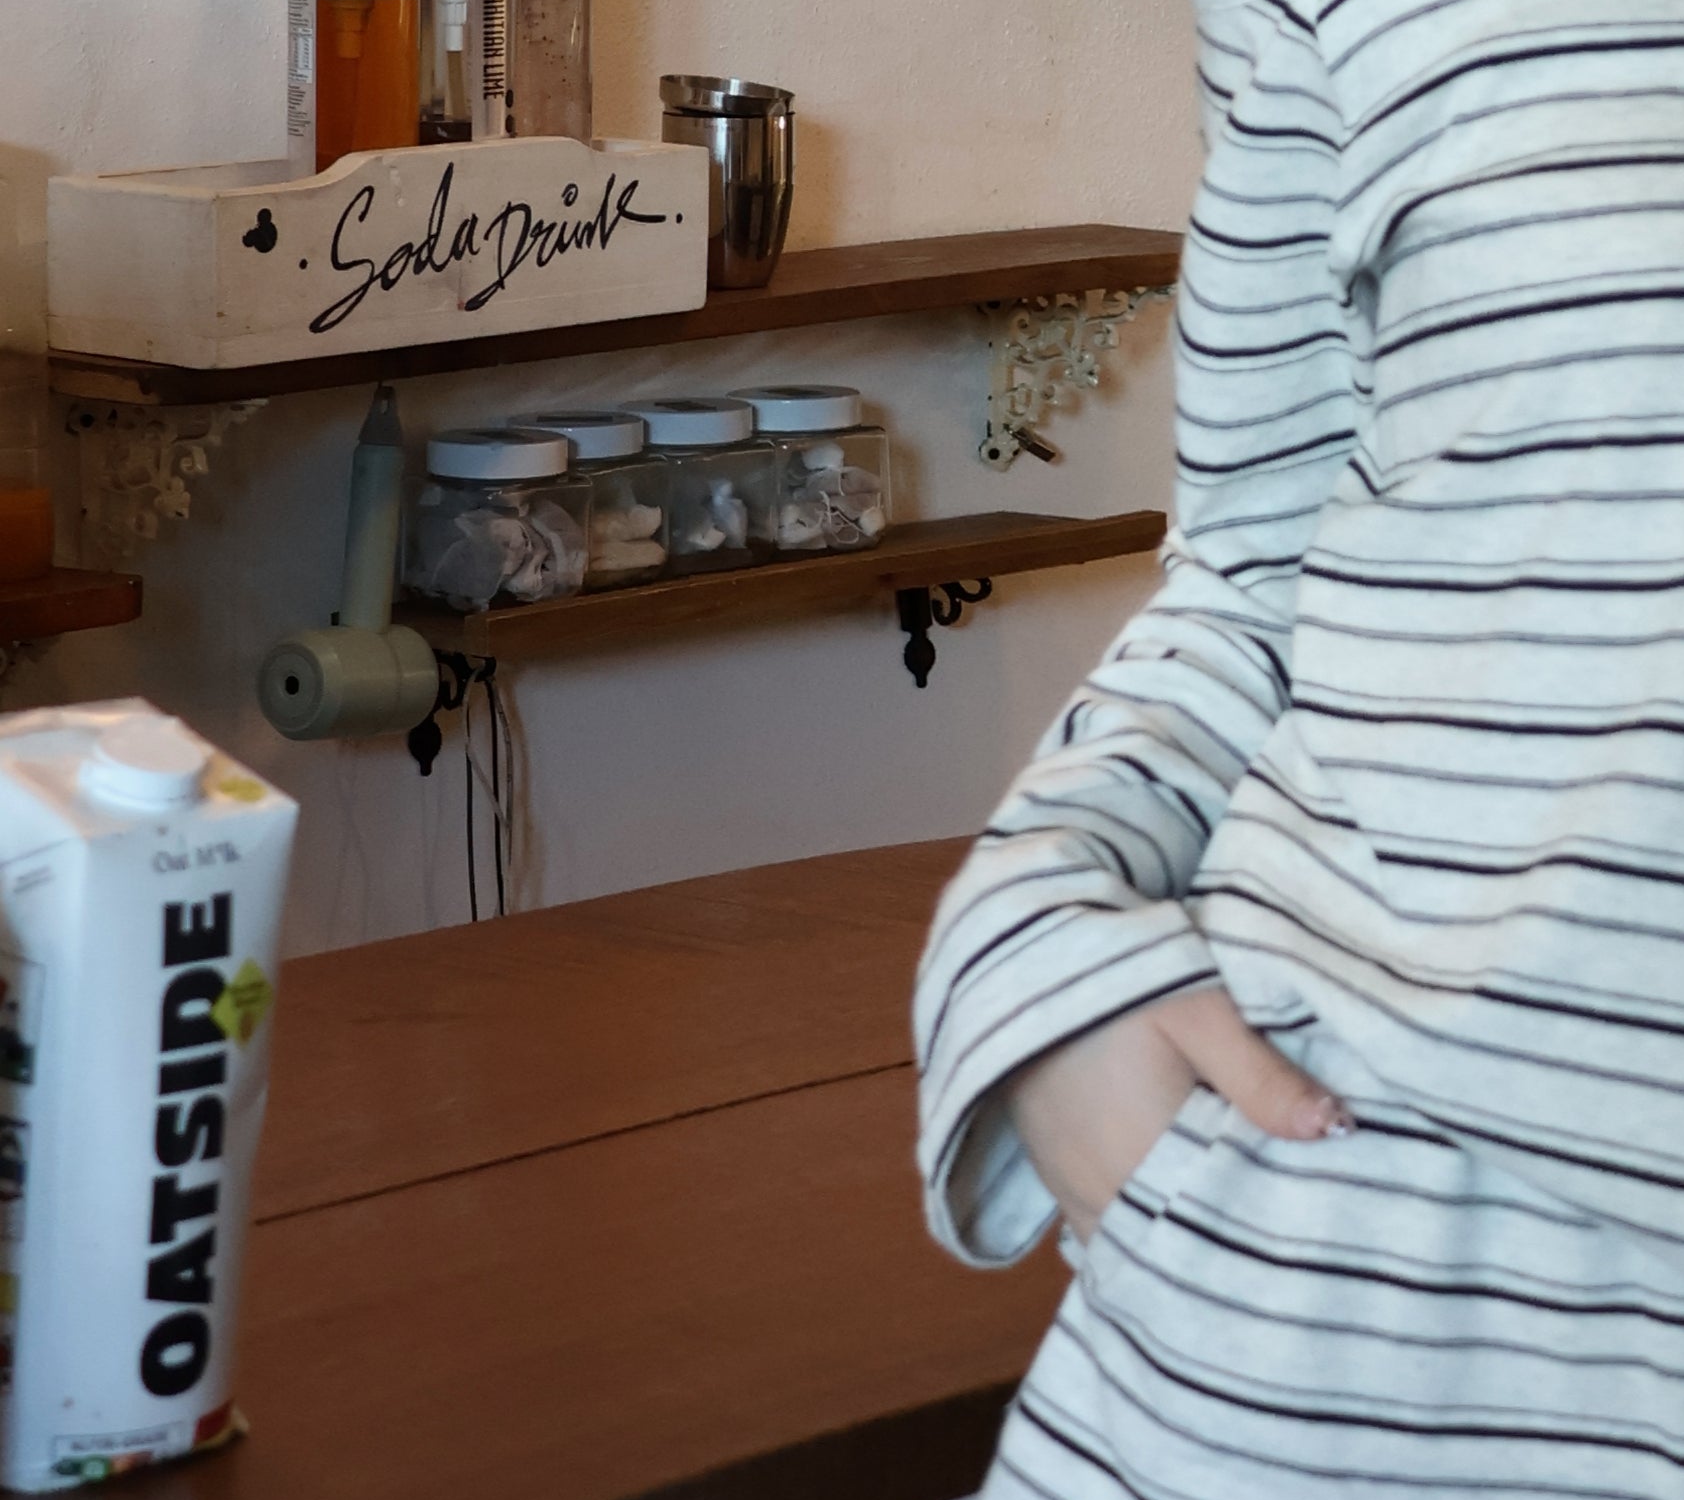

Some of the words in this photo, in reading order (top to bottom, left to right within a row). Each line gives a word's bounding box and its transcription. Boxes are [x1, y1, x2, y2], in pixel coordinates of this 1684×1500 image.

[483, 64, 505, 100] LIME
[309, 162, 479, 333] Soda
[140, 891, 234, 1398] OATSIDE
